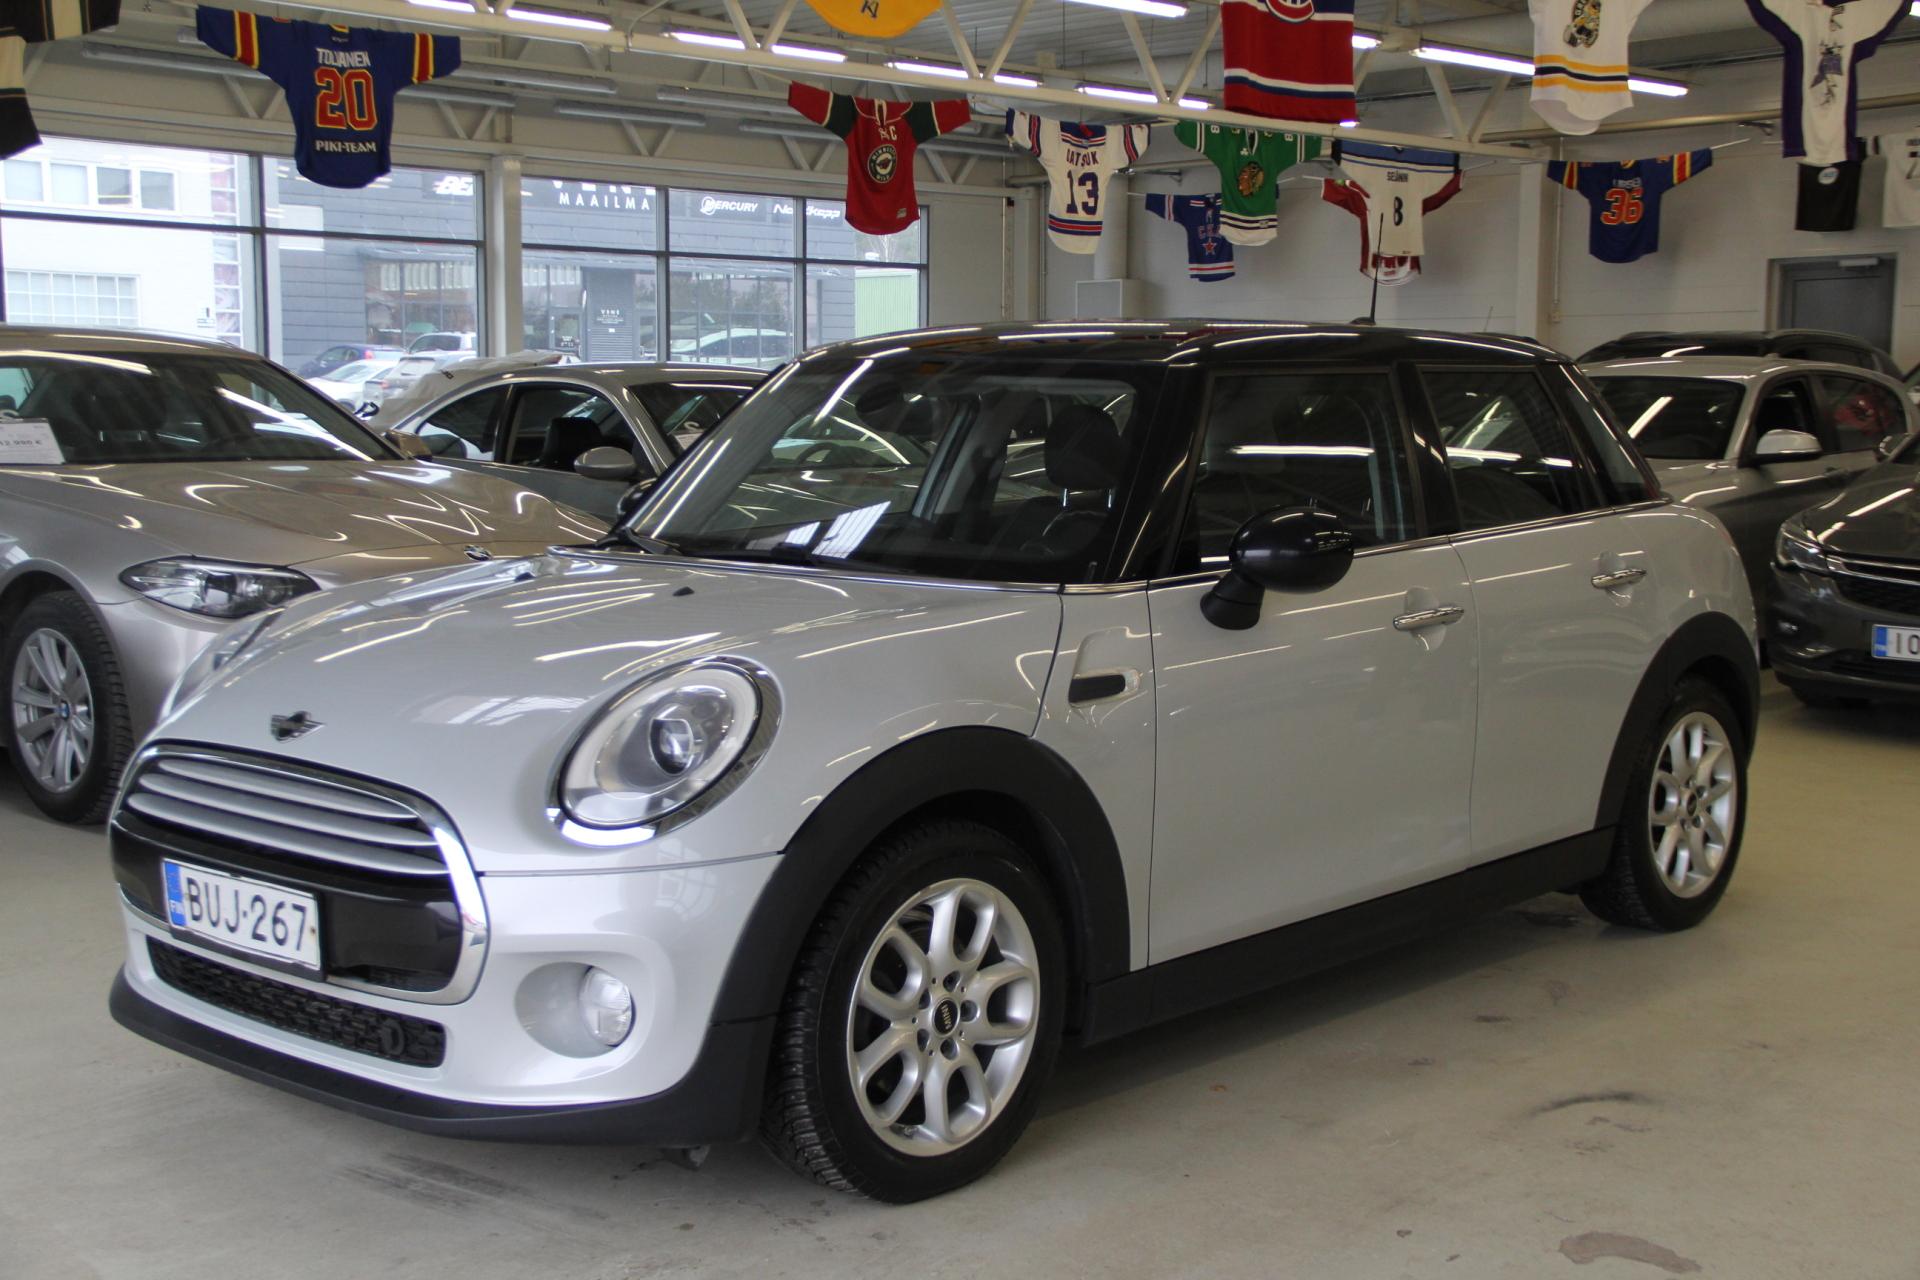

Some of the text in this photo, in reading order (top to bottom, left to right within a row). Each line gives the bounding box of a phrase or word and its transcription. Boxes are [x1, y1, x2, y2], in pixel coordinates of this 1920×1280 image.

[315, 67, 377, 130] 20
[315, 140, 376, 152] PIKI-TEAM
[559, 191, 650, 210] MAAILMA
[700, 196, 758, 215] MERCURY
[1066, 169, 1099, 215] 13
[1600, 187, 1644, 225] 36
[1393, 196, 1403, 226] 8
[186, 877, 308, 951] BUJ-267
